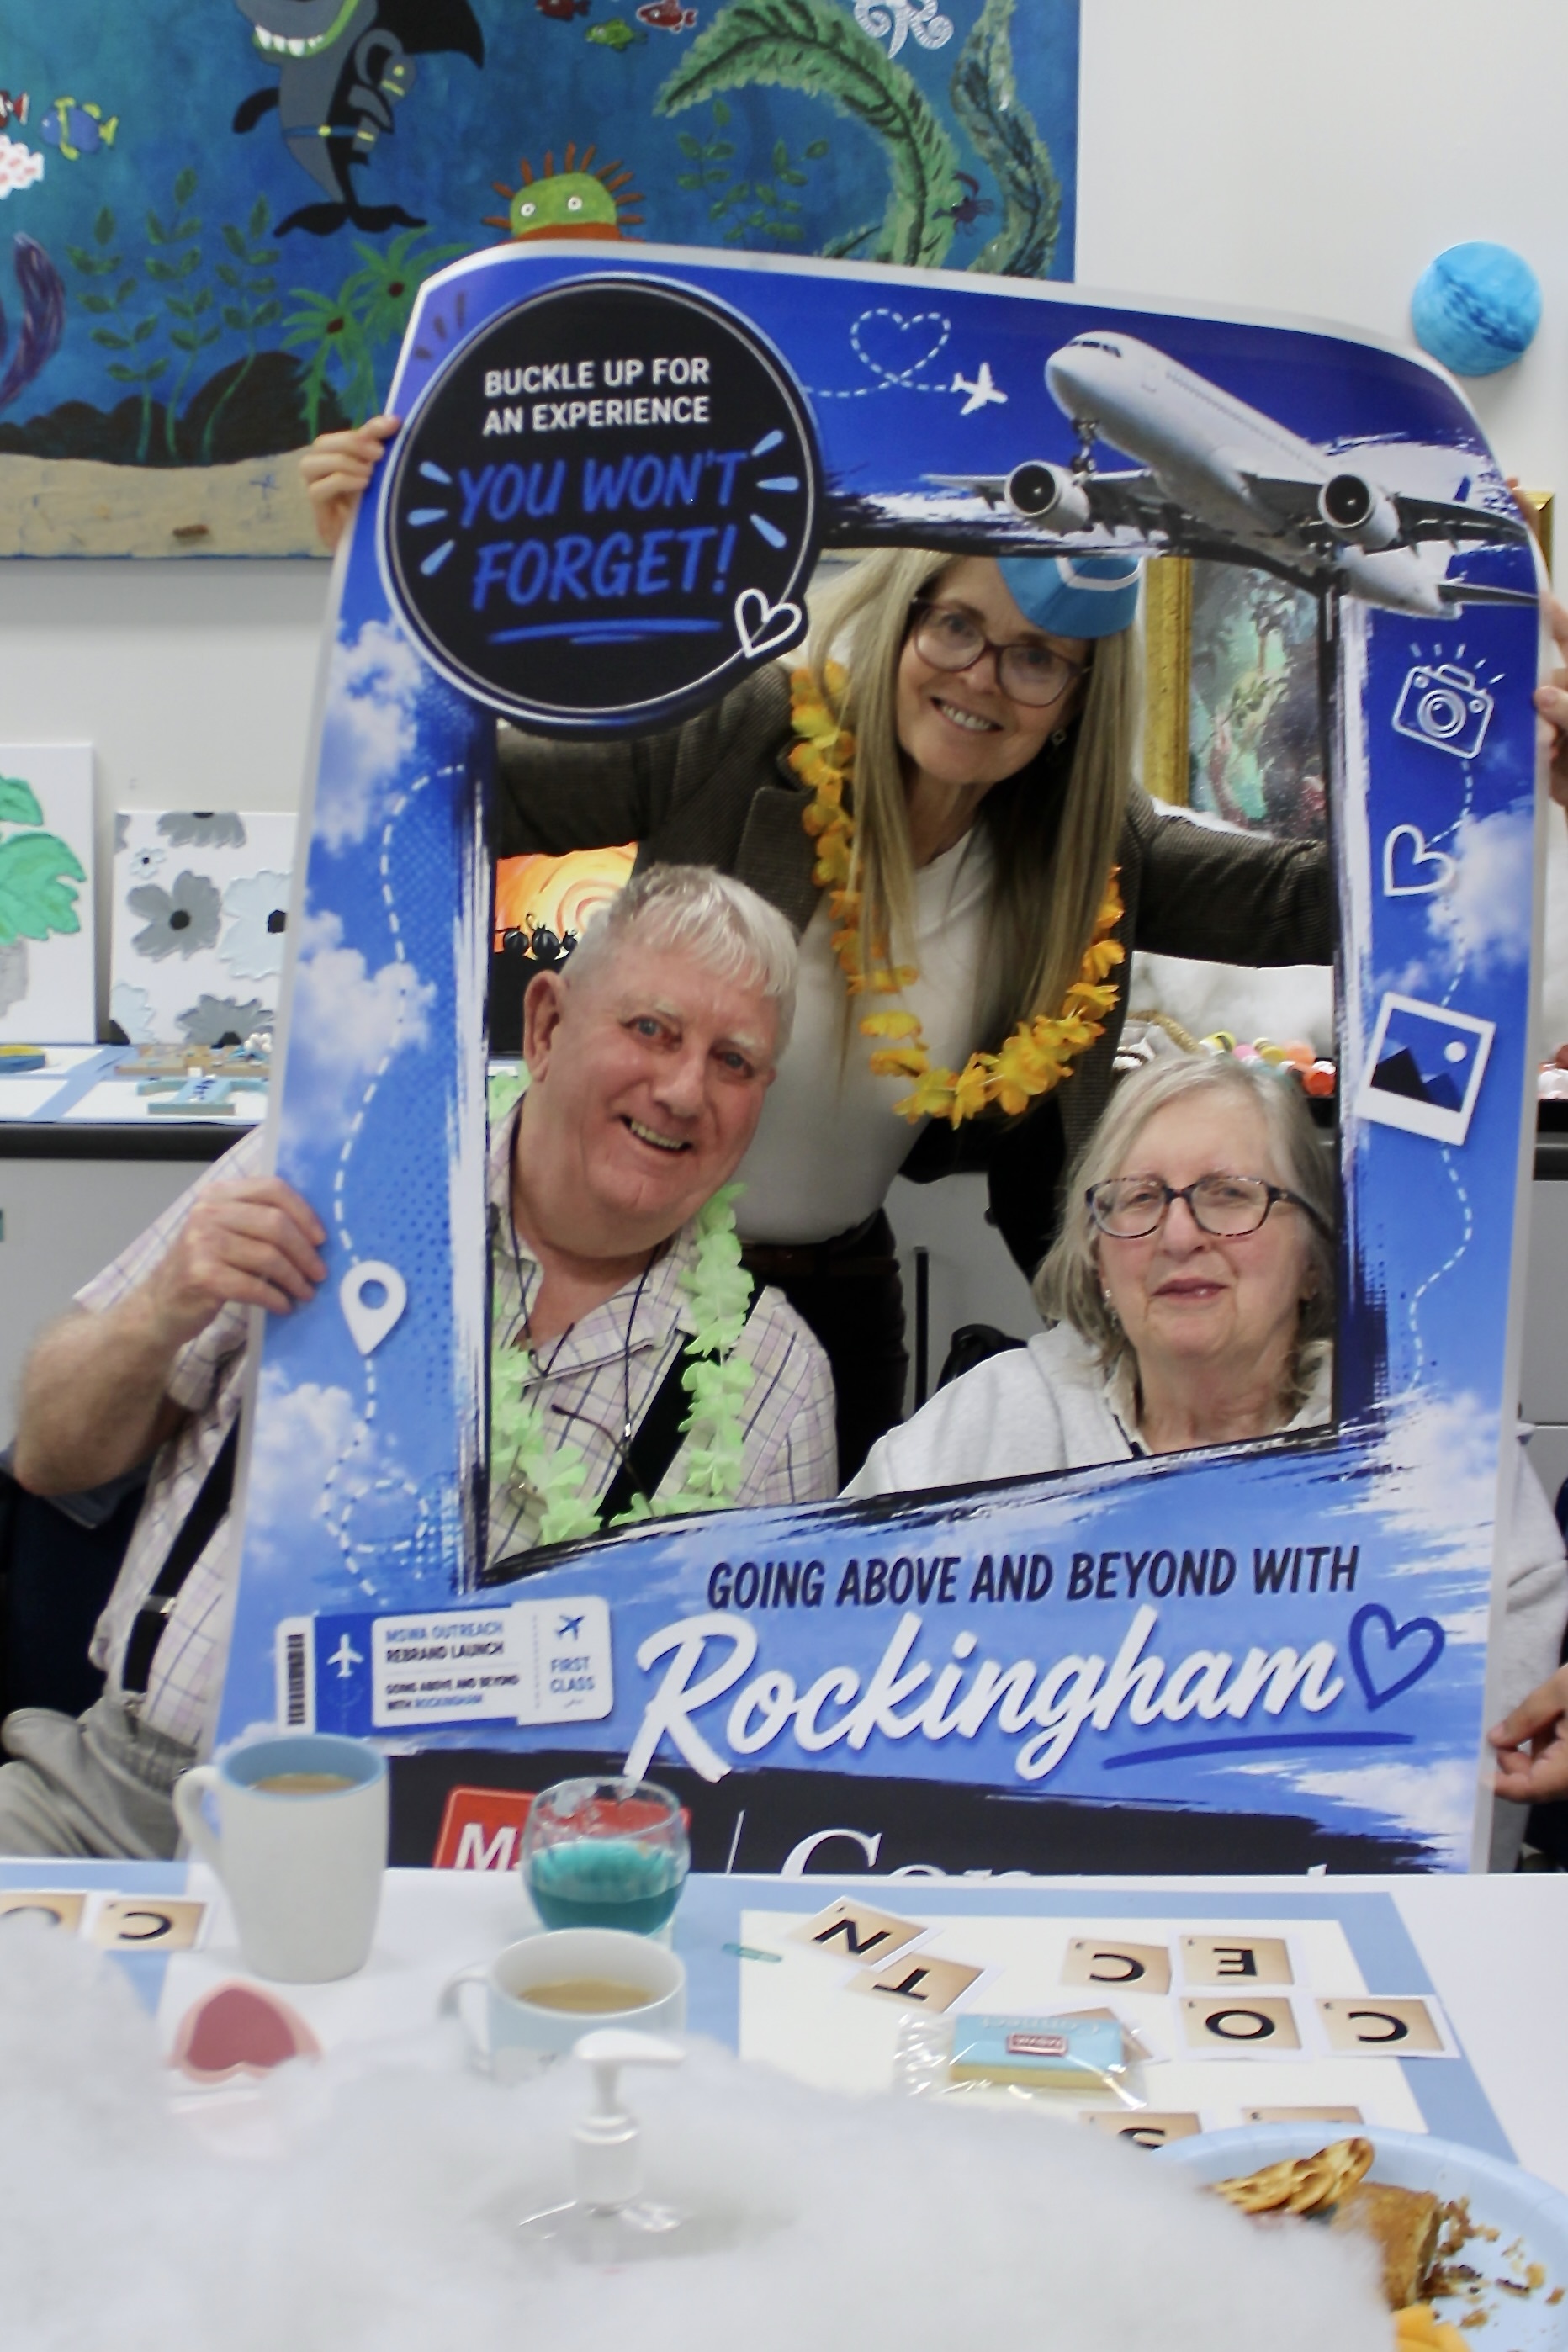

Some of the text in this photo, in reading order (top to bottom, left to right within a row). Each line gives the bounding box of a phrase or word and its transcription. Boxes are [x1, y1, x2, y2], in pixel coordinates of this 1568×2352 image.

[484, 357, 711, 398] BUCKLE UP FOR
[482, 395, 711, 437] AN EXPERIENCE
[459, 448, 750, 528] YOU WON'T
[472, 523, 738, 611] FORGET!
[707, 1544, 1360, 1610] GOING ABOVE AND BEYOND WITH
[432, 1621, 503, 1640] OUTREACH
[451, 1641, 504, 1660] LAUNCH
[551, 1655, 590, 1673] FIRST
[550, 1676, 596, 1694] CLASS
[621, 1603, 1345, 1792] Rockingham
[1089, 1952, 1145, 1984] C
[1212, 1947, 1258, 1977] E
[872, 1966, 930, 2002] T
[1205, 2010, 1276, 2042] O
[1348, 2011, 1410, 2044] C
